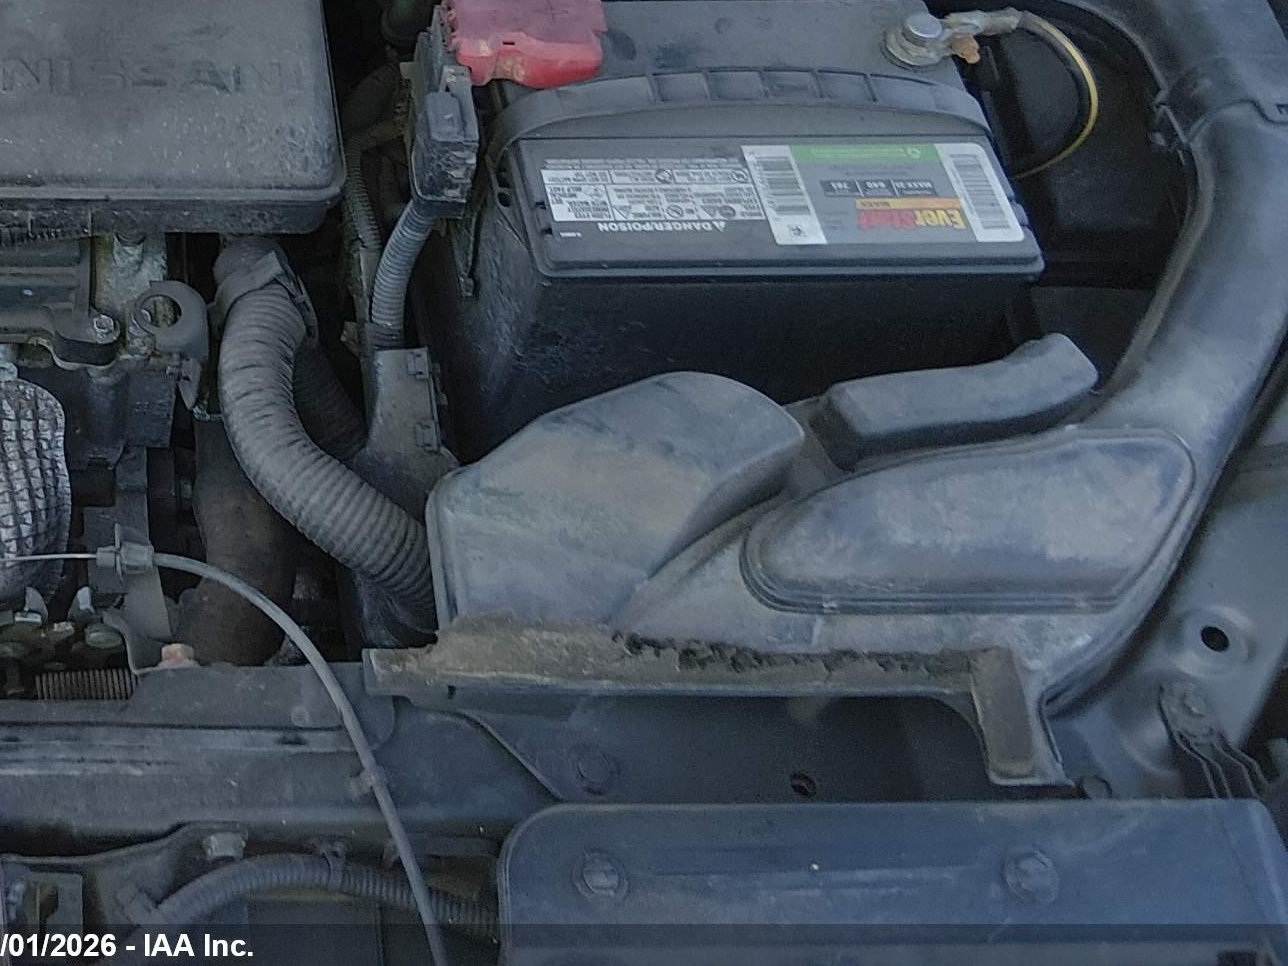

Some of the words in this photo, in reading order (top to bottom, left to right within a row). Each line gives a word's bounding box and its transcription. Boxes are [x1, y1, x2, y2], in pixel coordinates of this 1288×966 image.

[0, 56, 304, 93] NISSAN
[596, 221, 713, 232] DANGER/POISON
[859, 210, 967, 234] EverStart
